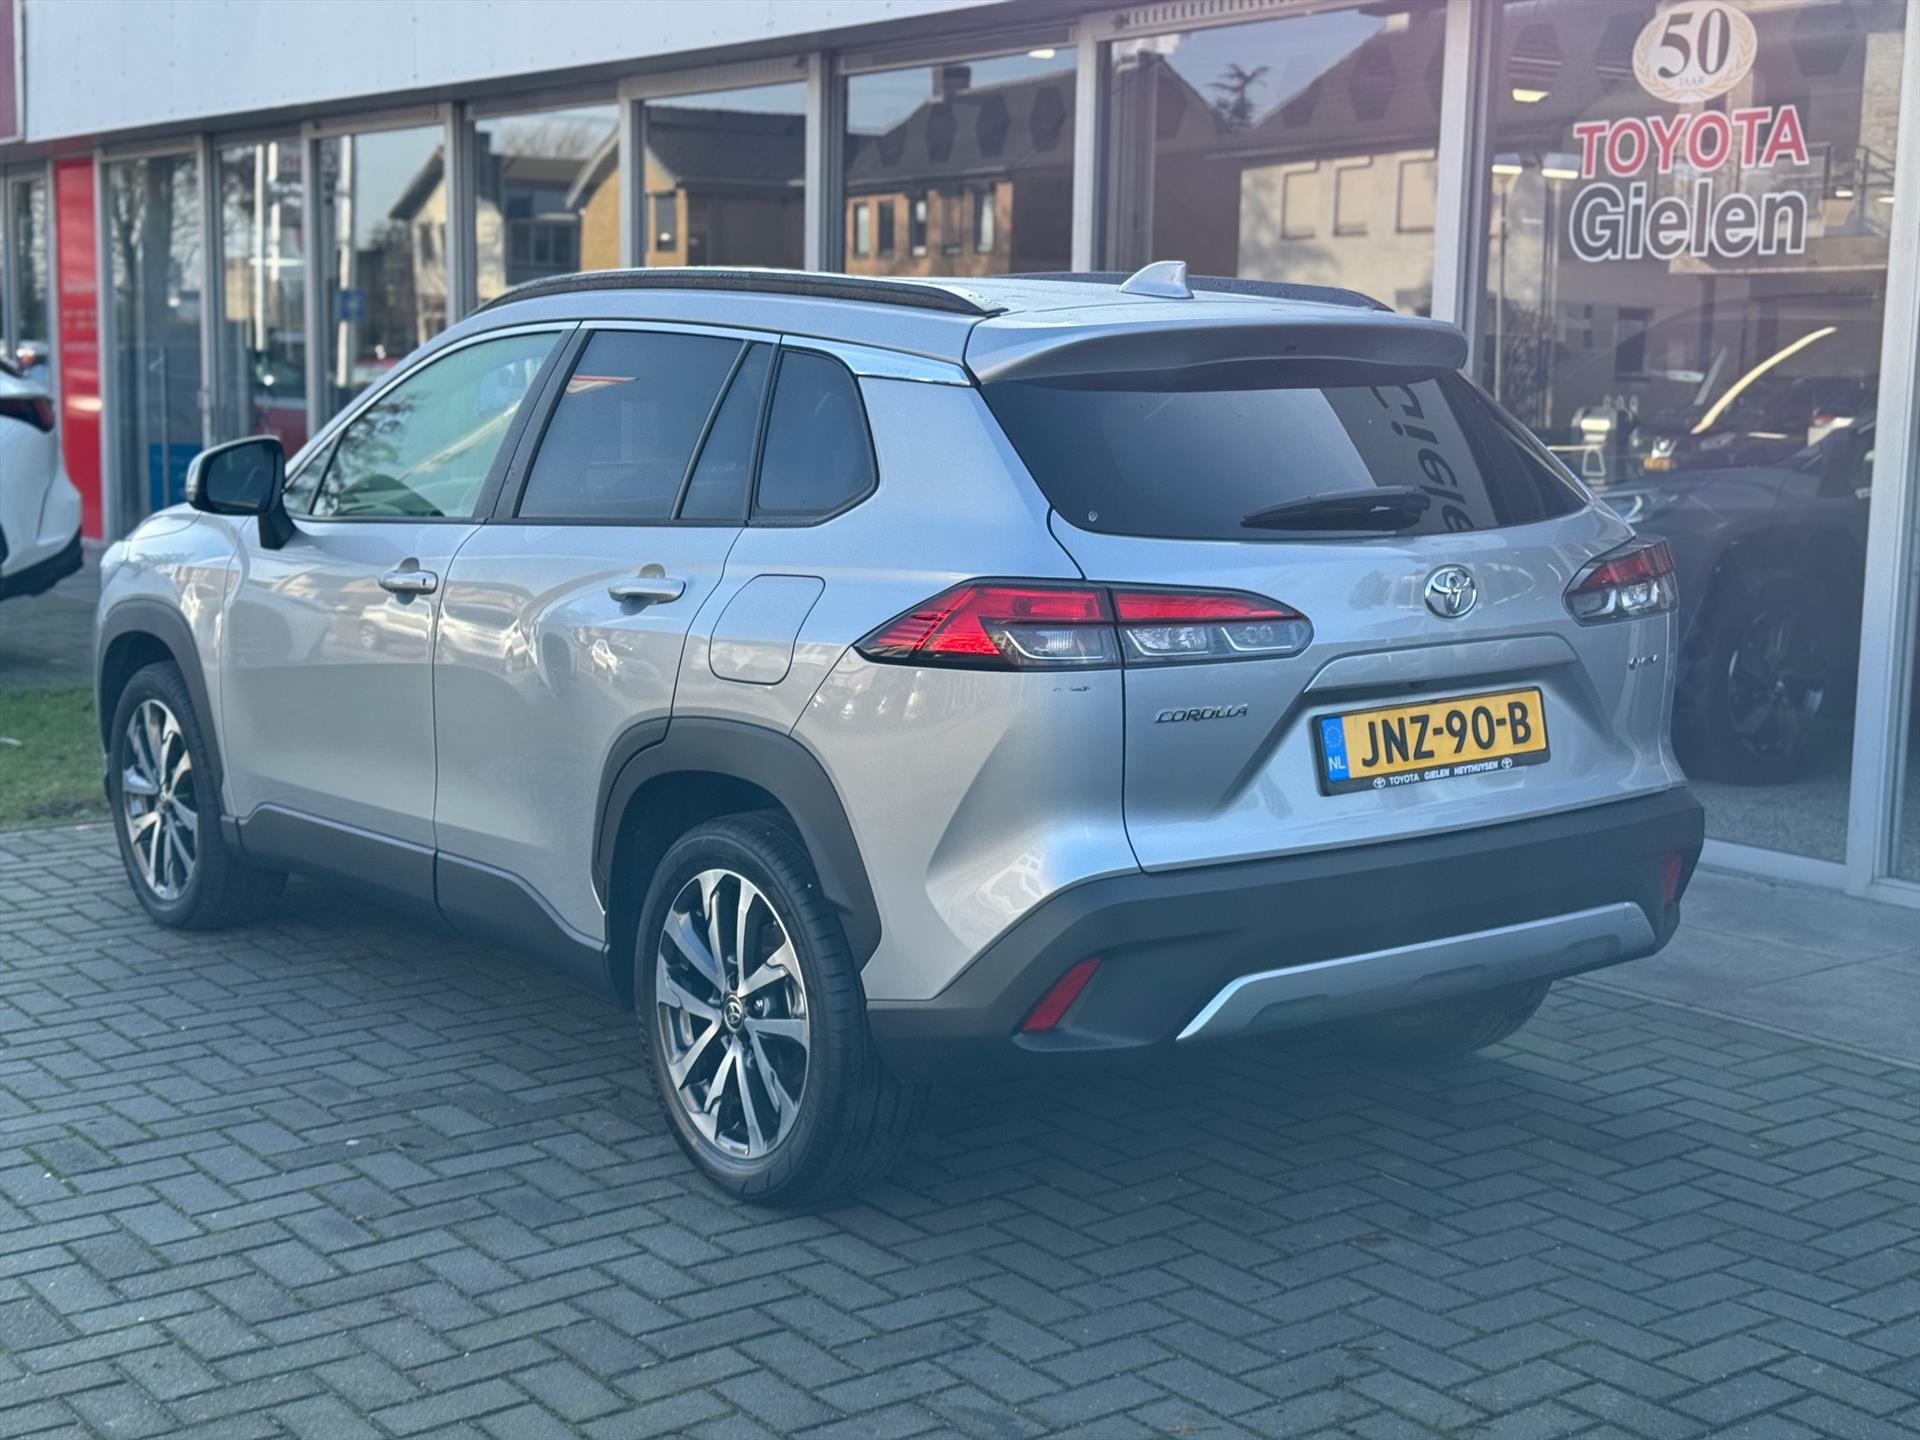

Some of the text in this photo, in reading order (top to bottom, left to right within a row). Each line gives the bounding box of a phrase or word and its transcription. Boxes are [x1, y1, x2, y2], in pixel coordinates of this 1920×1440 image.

[1658, 8, 1731, 78] 50
[1573, 105, 1810, 179] TOYOTA
[1569, 178, 1808, 262] Gielen
[1154, 703, 1248, 723] COROLLA
[1362, 701, 1532, 768] JNZ-90-B
[1328, 756, 1346, 770] NL
[1388, 761, 1498, 785] TOYOTA GIELEN HEYTHUYSEN
